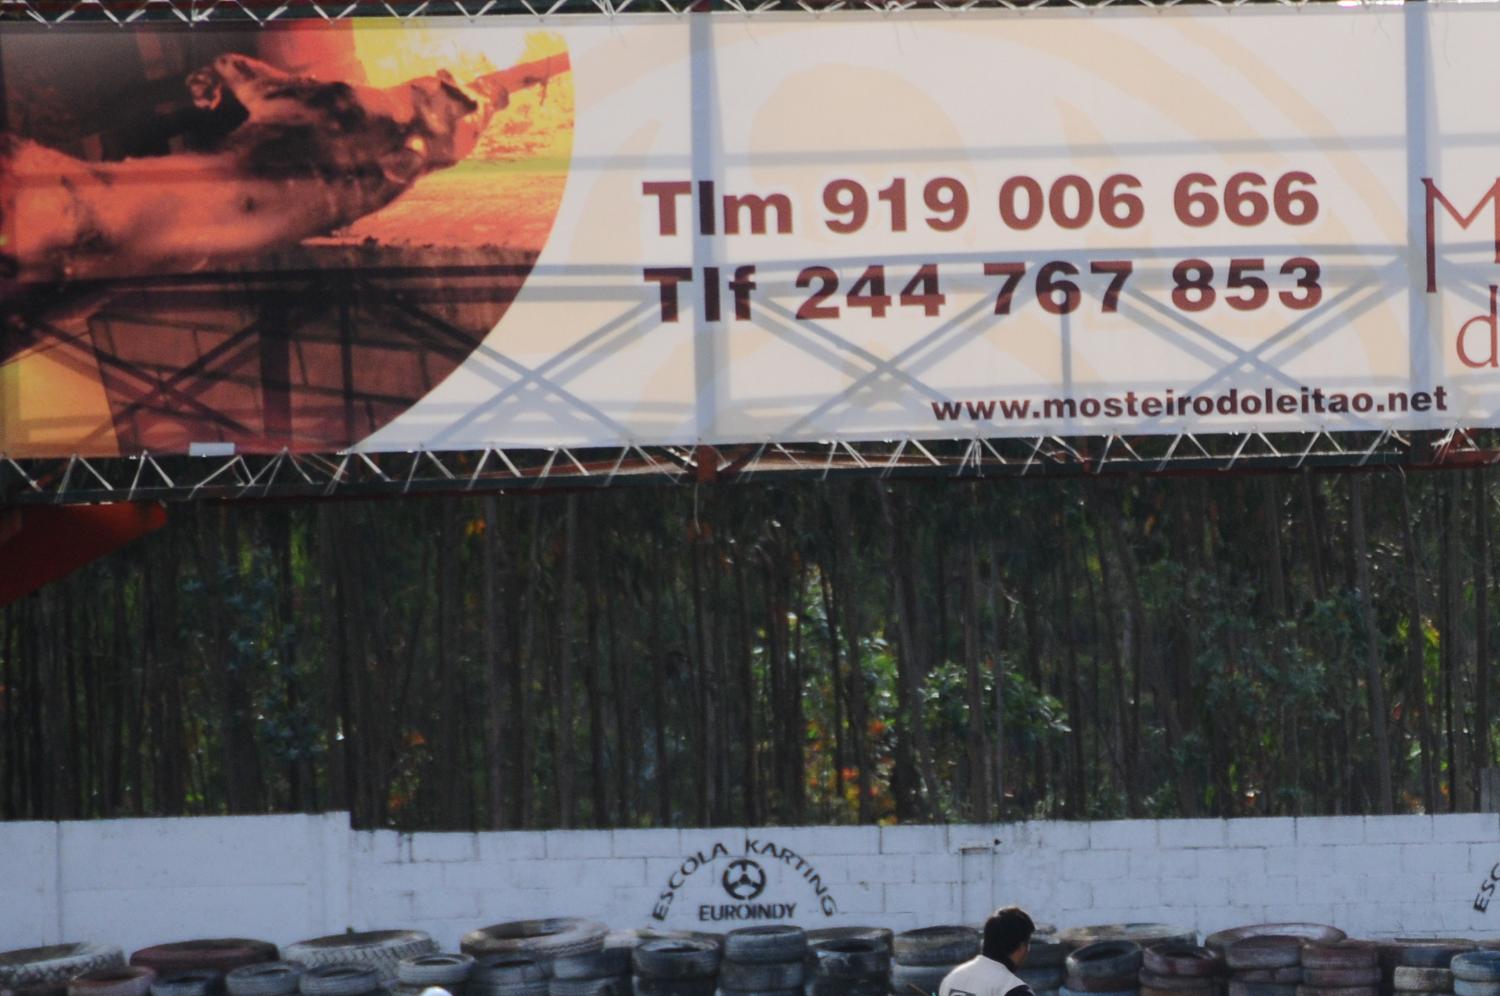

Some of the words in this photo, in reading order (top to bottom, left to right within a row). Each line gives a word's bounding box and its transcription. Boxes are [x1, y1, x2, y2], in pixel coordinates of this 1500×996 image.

[642, 180, 793, 236] Tlm
[822, 177, 970, 233] 919
[999, 174, 1145, 230] 006
[1173, 171, 1320, 227] 666
[642, 265, 757, 323] Tlf
[795, 264, 946, 320] 244
[983, 260, 1134, 315] 767
[1171, 257, 1324, 312] 853
[931, 385, 1448, 423] www.mosteirodoleitao.net
[652, 842, 729, 921] ESCOLA
[745, 838, 837, 917] KARTING
[699, 903, 797, 921] EUROINDY
